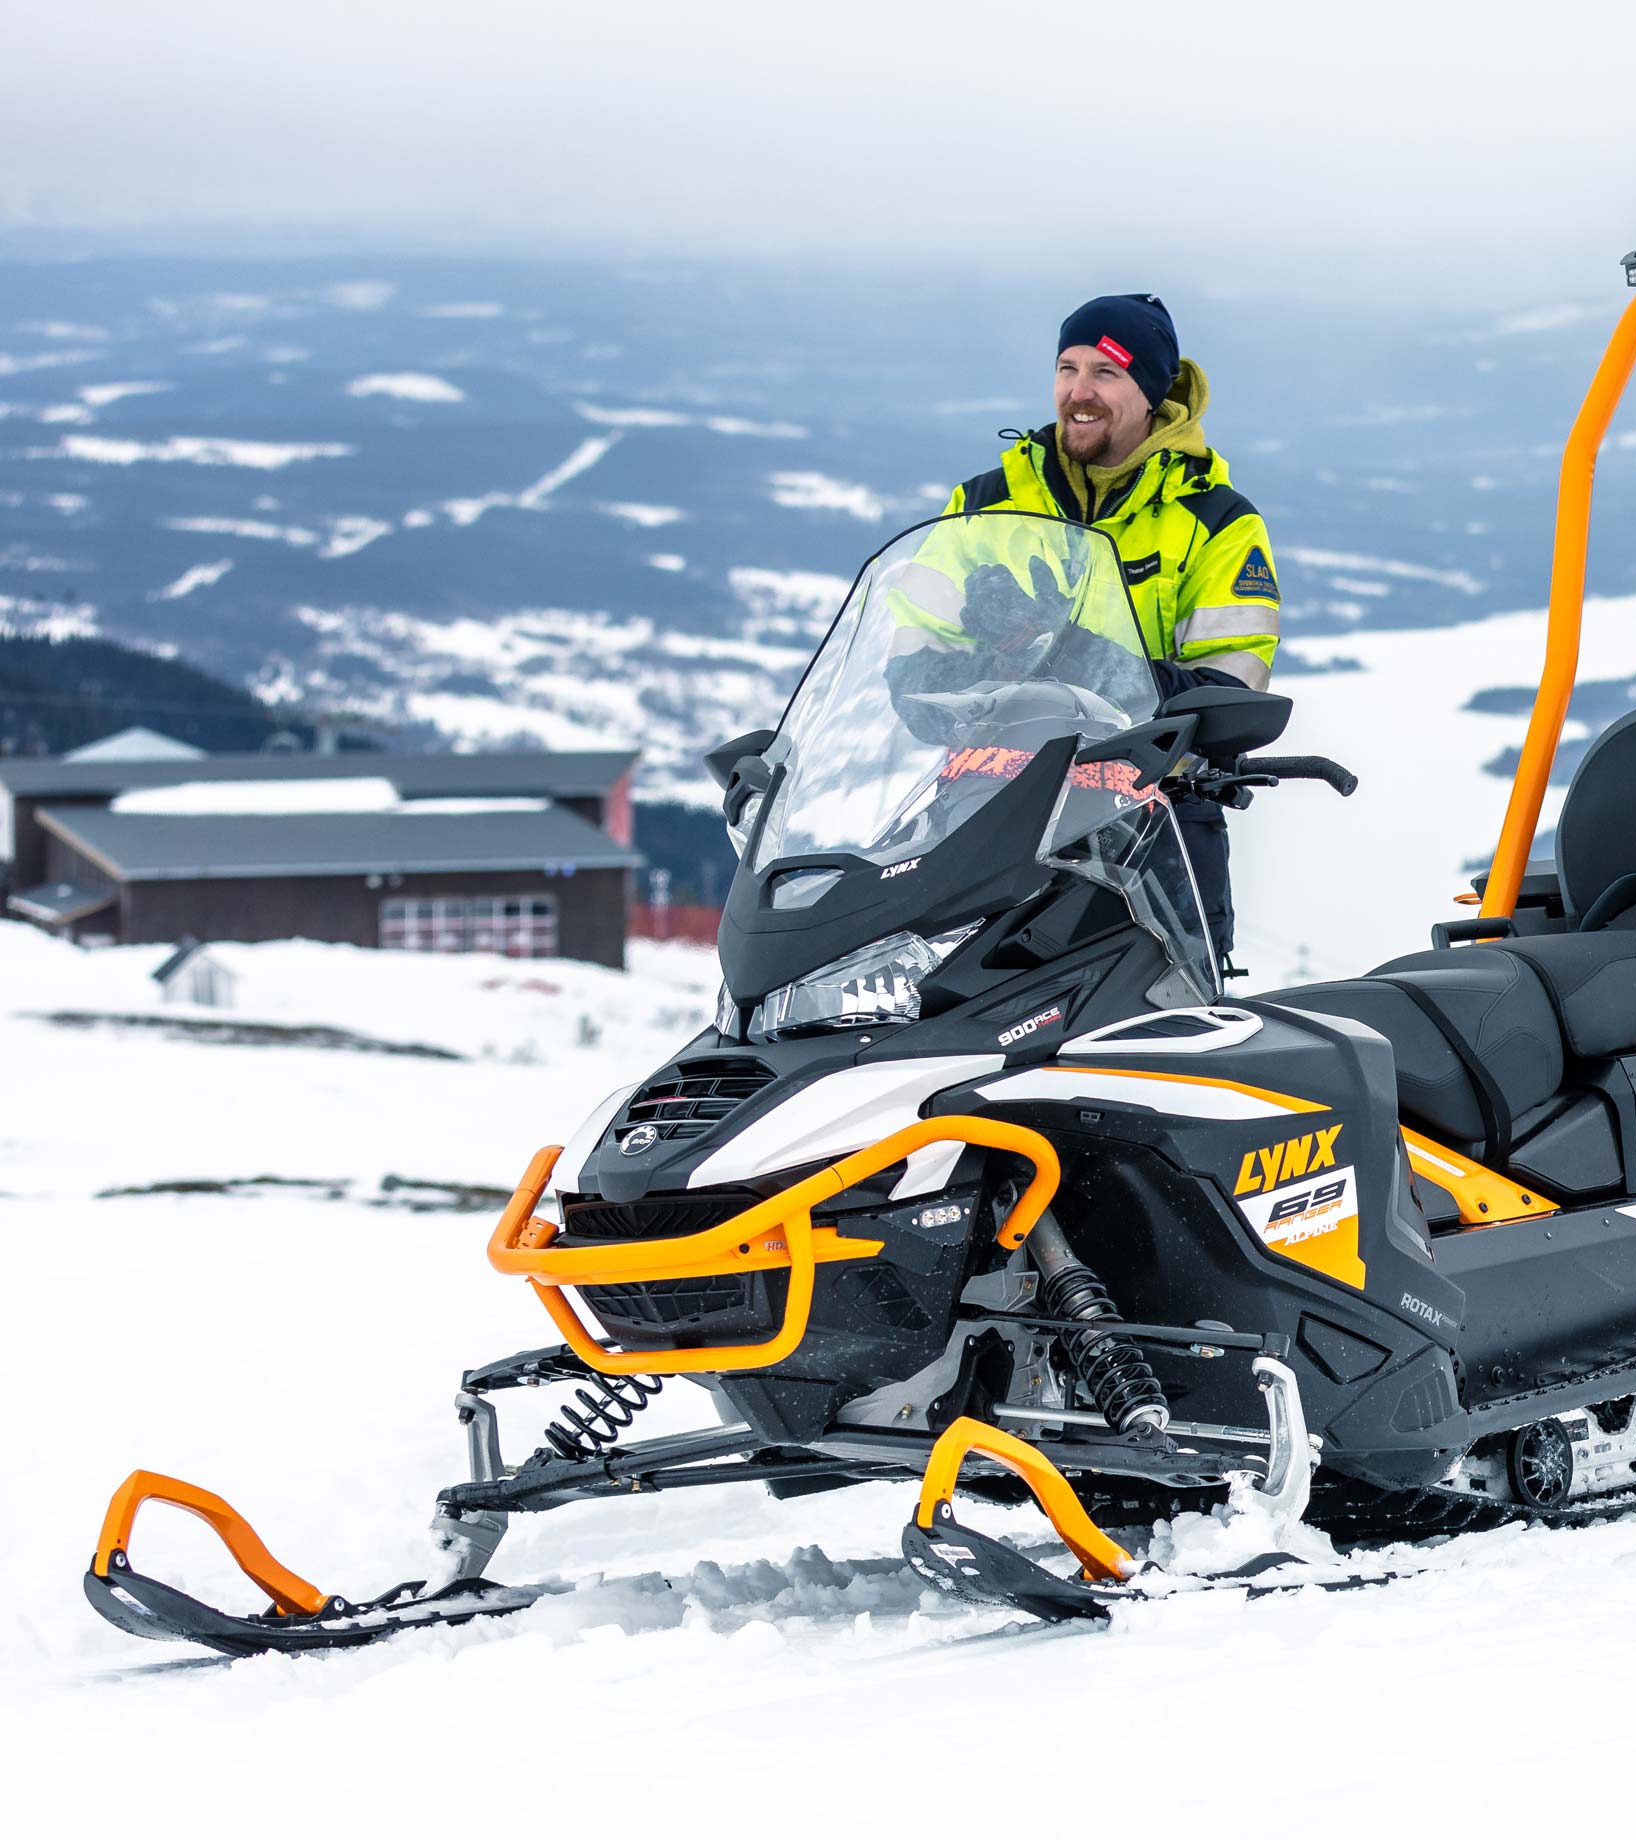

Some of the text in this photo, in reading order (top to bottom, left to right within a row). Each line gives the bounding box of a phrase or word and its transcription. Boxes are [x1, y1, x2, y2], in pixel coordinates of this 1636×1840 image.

[1245, 563, 1269, 580] SLAO
[880, 857, 922, 880] LYNX
[998, 1018, 1038, 1047] 900
[1033, 1006, 1060, 1025] ACE
[1233, 1123, 1343, 1196] LYNX
[1263, 1199, 1343, 1234] RANGER
[1268, 1179, 1347, 1223] 69
[1283, 1220, 1339, 1247] ALPINE
[1400, 1292, 1442, 1327] ROTAX
